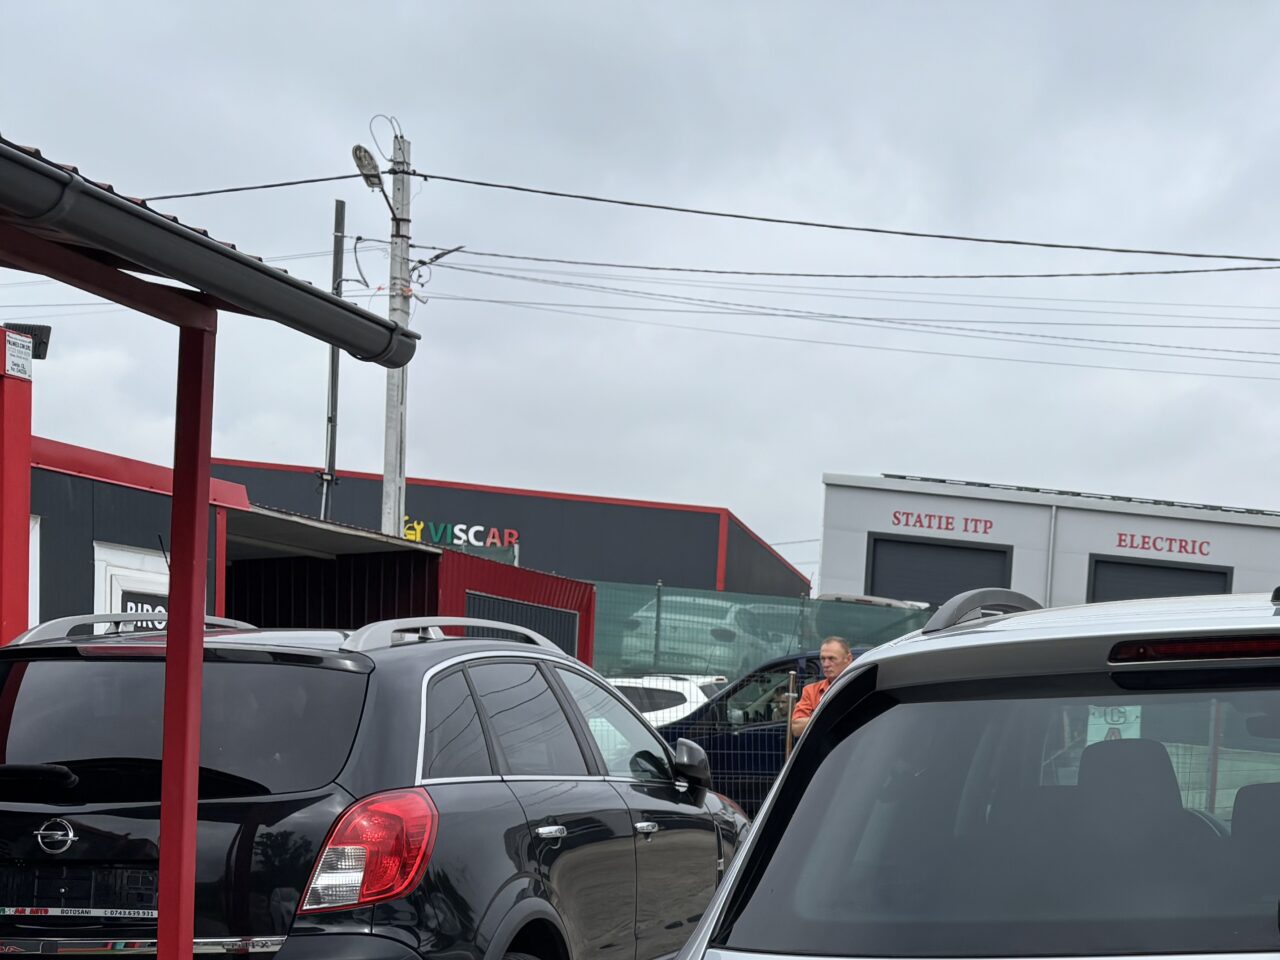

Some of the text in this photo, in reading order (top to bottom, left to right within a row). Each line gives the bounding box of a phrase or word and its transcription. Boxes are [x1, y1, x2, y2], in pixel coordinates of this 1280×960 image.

[892, 510, 993, 534] STATIE ITP
[428, 522, 520, 548] VISCAR
[1116, 533, 1210, 556] ELECTRIC
